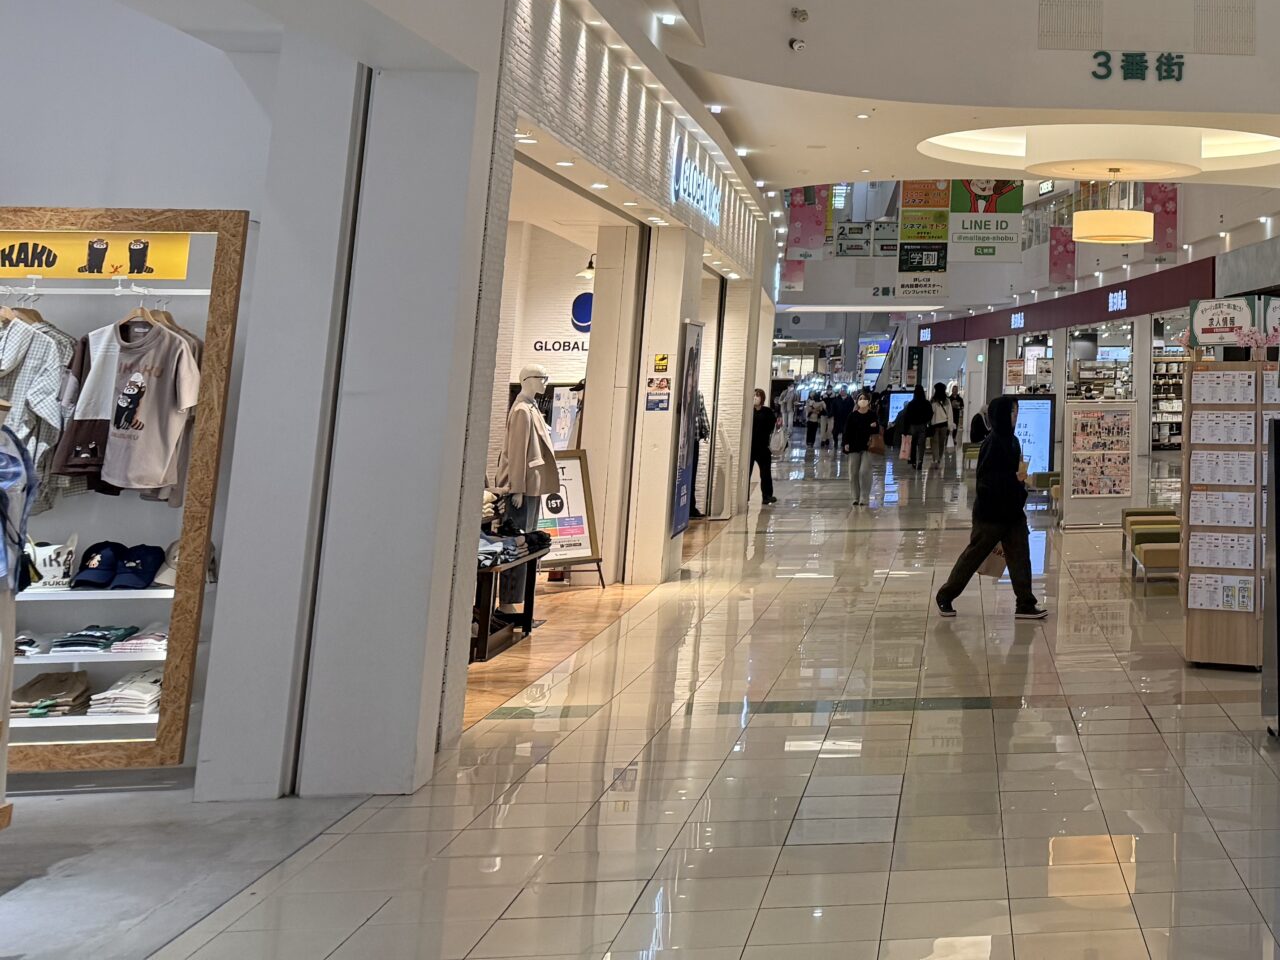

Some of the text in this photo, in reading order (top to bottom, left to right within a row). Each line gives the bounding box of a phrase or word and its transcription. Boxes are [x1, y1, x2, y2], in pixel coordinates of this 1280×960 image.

[1092, 50, 1184, 81] 3番街
[961, 219, 1009, 231] LINE ID
[910, 251, 936, 265] 学割
[533, 340, 589, 352] GLOBAL
